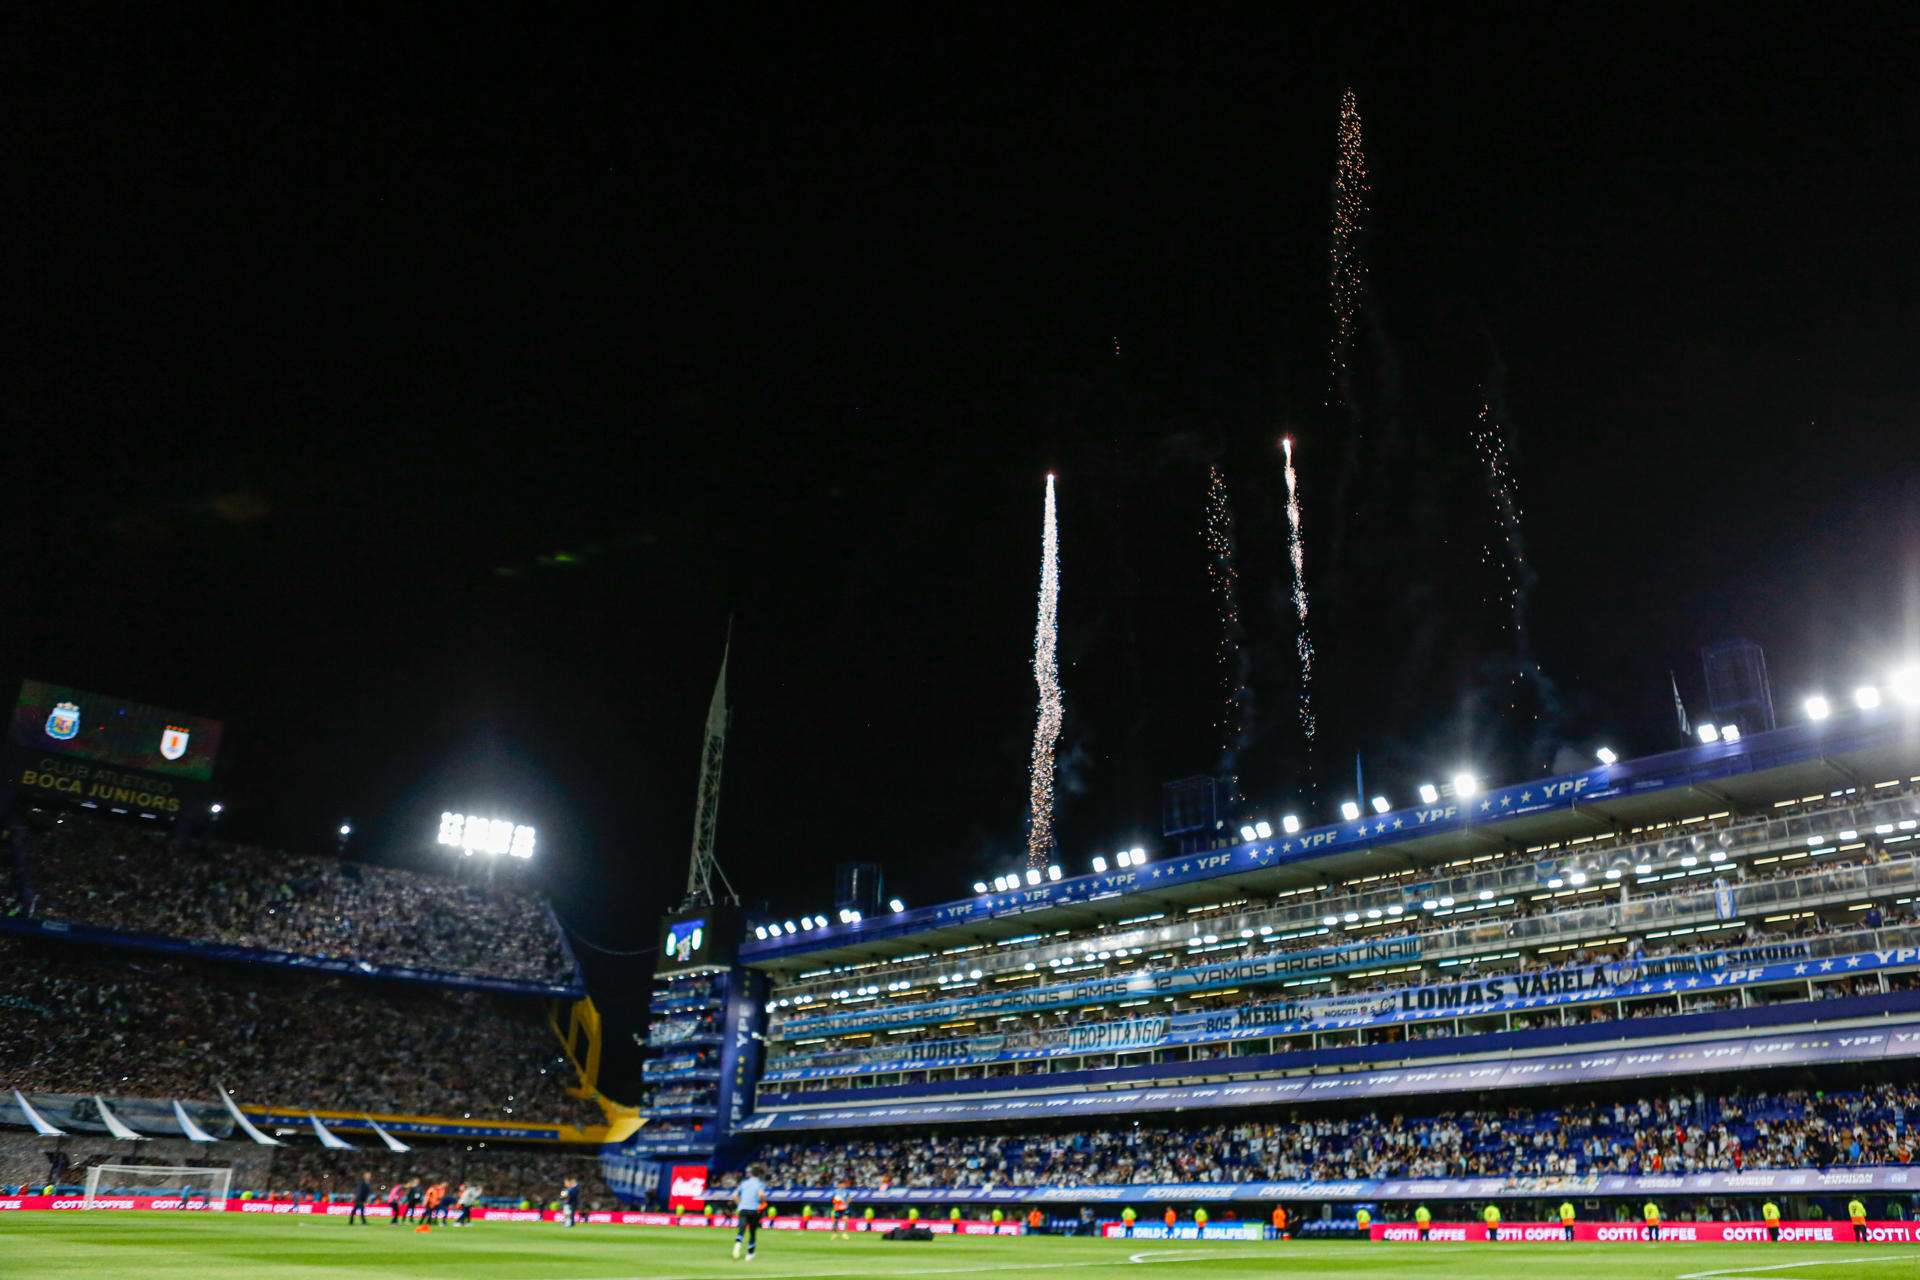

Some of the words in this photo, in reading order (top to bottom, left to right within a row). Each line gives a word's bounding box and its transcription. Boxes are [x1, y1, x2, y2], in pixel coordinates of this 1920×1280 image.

[40, 758, 88, 776] CLUB
[22, 770, 83, 793] BOCA
[88, 780, 181, 812] JUNIORS
[947, 904, 973, 917] YPF
[1024, 888, 1051, 901] YPF
[1106, 872, 1137, 888] YPF
[1197, 853, 1232, 871] YPF
[1300, 831, 1338, 849] YPF
[1416, 807, 1457, 824] YPF
[1542, 778, 1589, 799] YPF
[1072, 982, 1127, 999] JAMAS
[1153, 976, 1172, 990] 12
[1191, 961, 1268, 985] VAMOS
[1711, 967, 1764, 985] YPF
[1402, 978, 1504, 1011] LOMAS
[1513, 966, 1608, 999] VARELA
[1206, 1016, 1232, 1033] 805
[1239, 1003, 1296, 1026] MERLO
[736, 1003, 752, 1048] YPF
[1069, 1019, 1161, 1049] TROPITANGO
[911, 1040, 969, 1060] FLORES
[1143, 1186, 1237, 1199] POWERADE
[1384, 1228, 1418, 1241] COTTI
[1424, 1228, 1466, 1241] OFFEE
[1597, 1227, 1638, 1240] COTTI
[1723, 1227, 1768, 1241] COTTI
